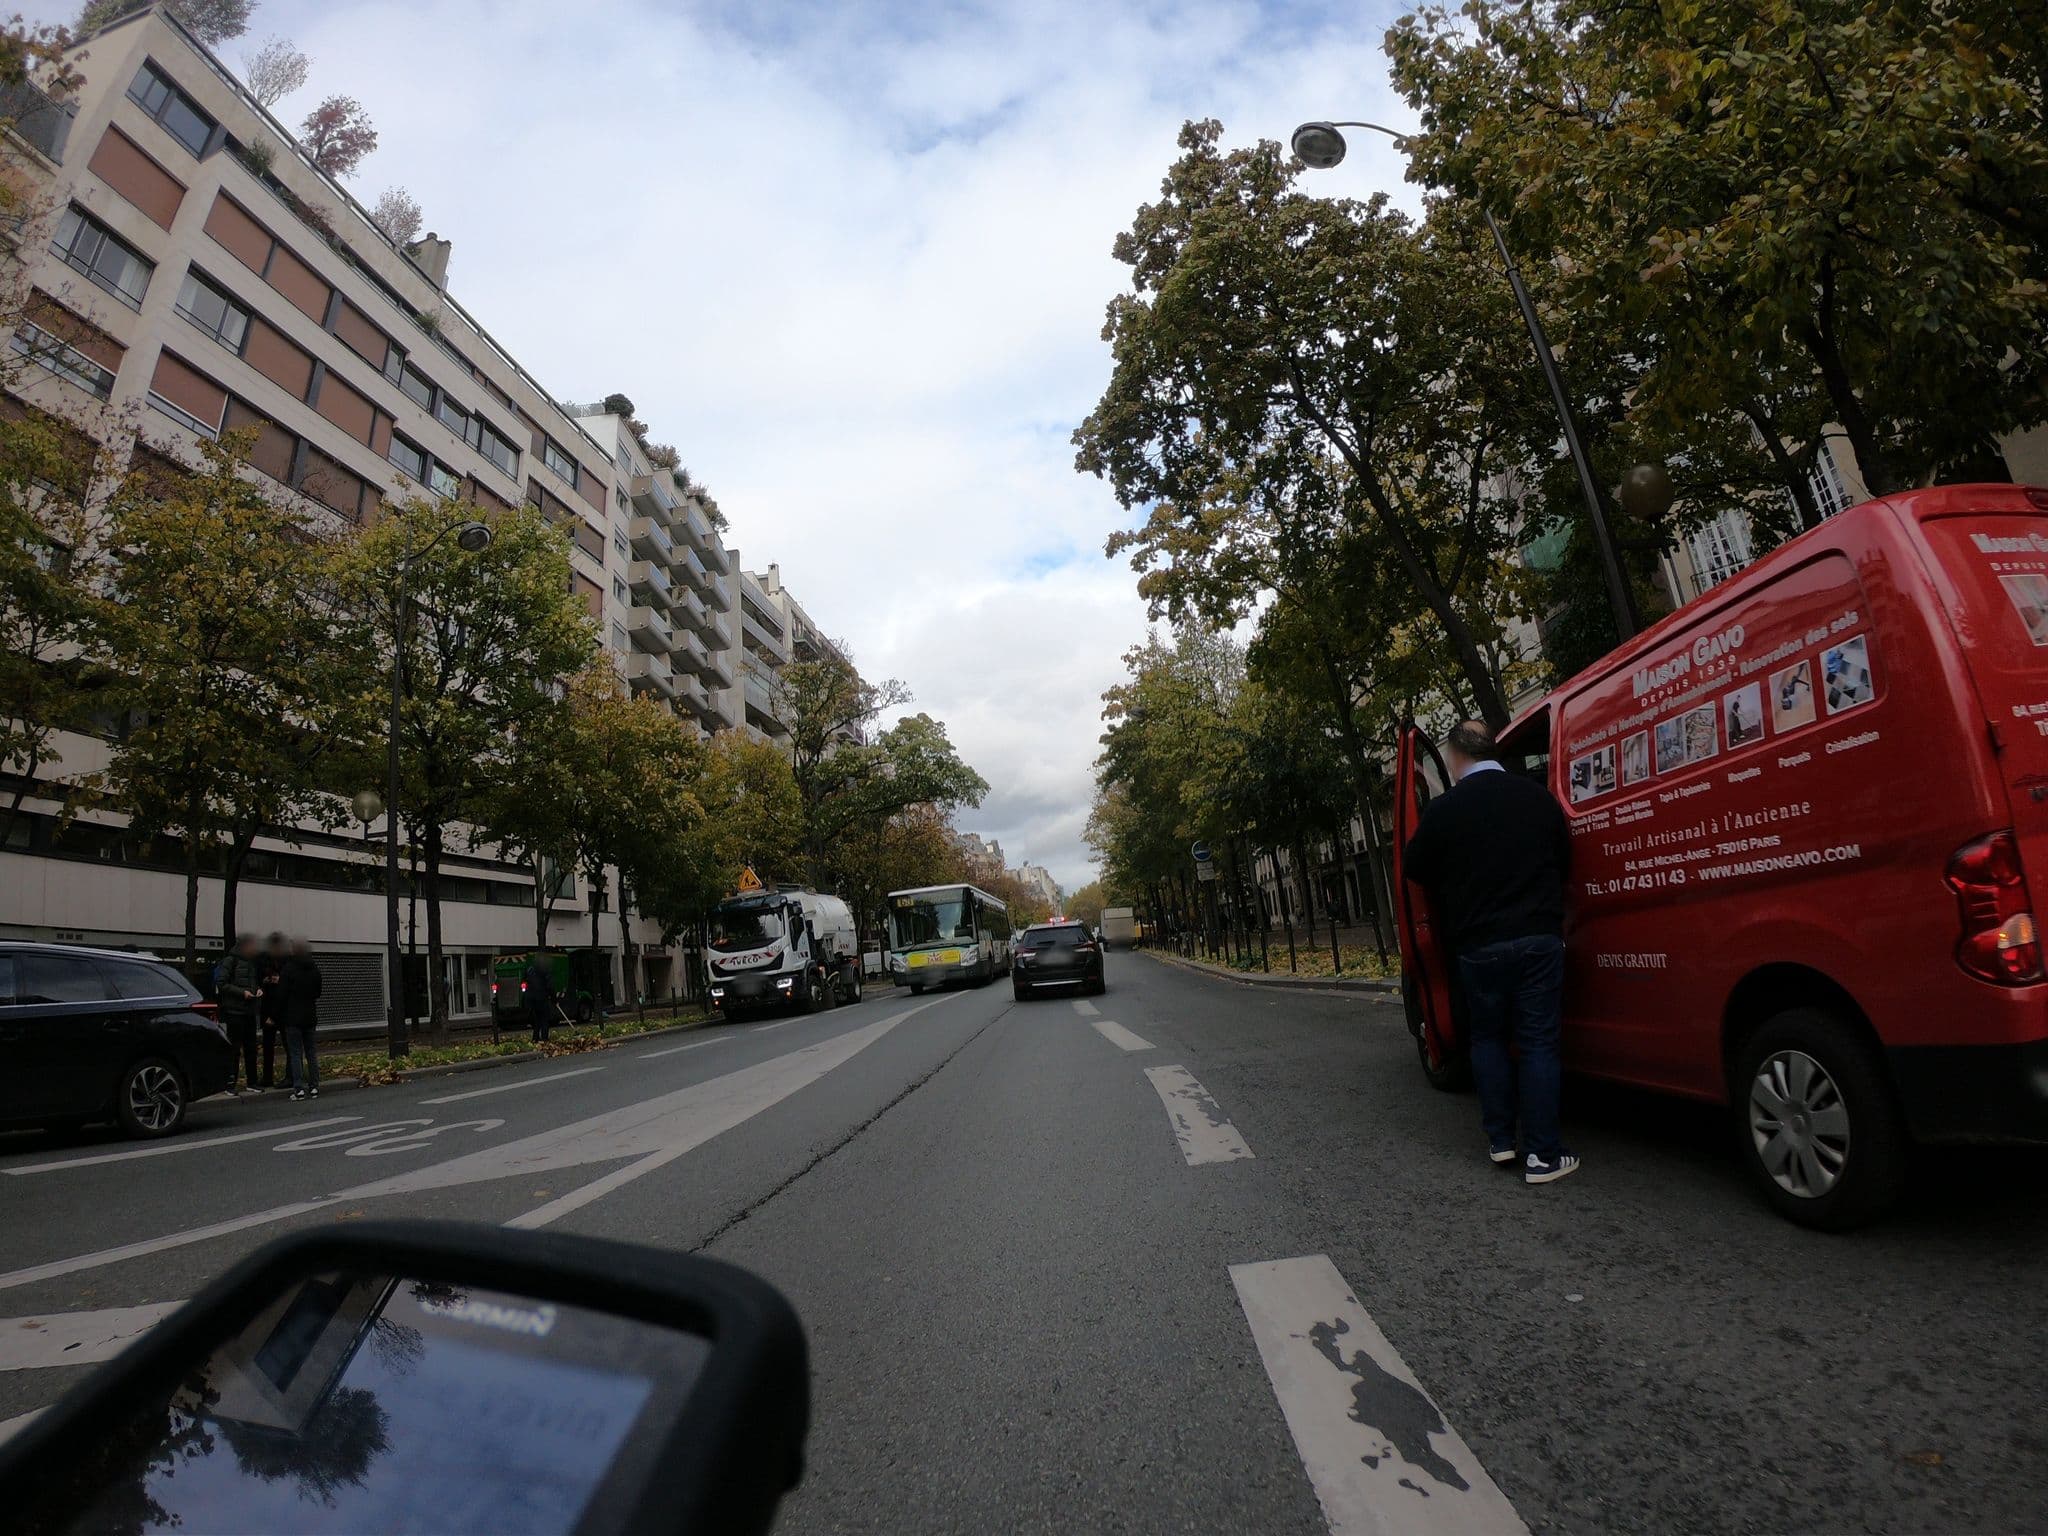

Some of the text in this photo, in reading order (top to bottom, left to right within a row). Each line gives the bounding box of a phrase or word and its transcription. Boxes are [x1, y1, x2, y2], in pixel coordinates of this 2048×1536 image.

[1607, 722, 1618, 737] du
[1618, 706, 1659, 732] Nettoyage
[1739, 640, 1803, 676] Rénovation
[1804, 626, 1829, 645] des
[1830, 611, 1859, 634] sols
[1632, 623, 1745, 698] MAISON GAVO
[1641, 654, 1738, 707] DEPUIS 1939
[1602, 801, 1811, 857] Travail Artisanal à l'Ancienne
[1716, 838, 1748, 856] 75016
[1748, 835, 1782, 849] PARIS
[1608, 878, 1621, 893] 01
[1622, 874, 1636, 891] 47
[1637, 871, 1653, 889] 43
[1655, 869, 1667, 887] 11
[1669, 867, 1686, 885] 43
[1698, 844, 1861, 881] WWW.MAISONGAVO.COM
[1597, 952, 1668, 968] DEVIS GRATUIT
